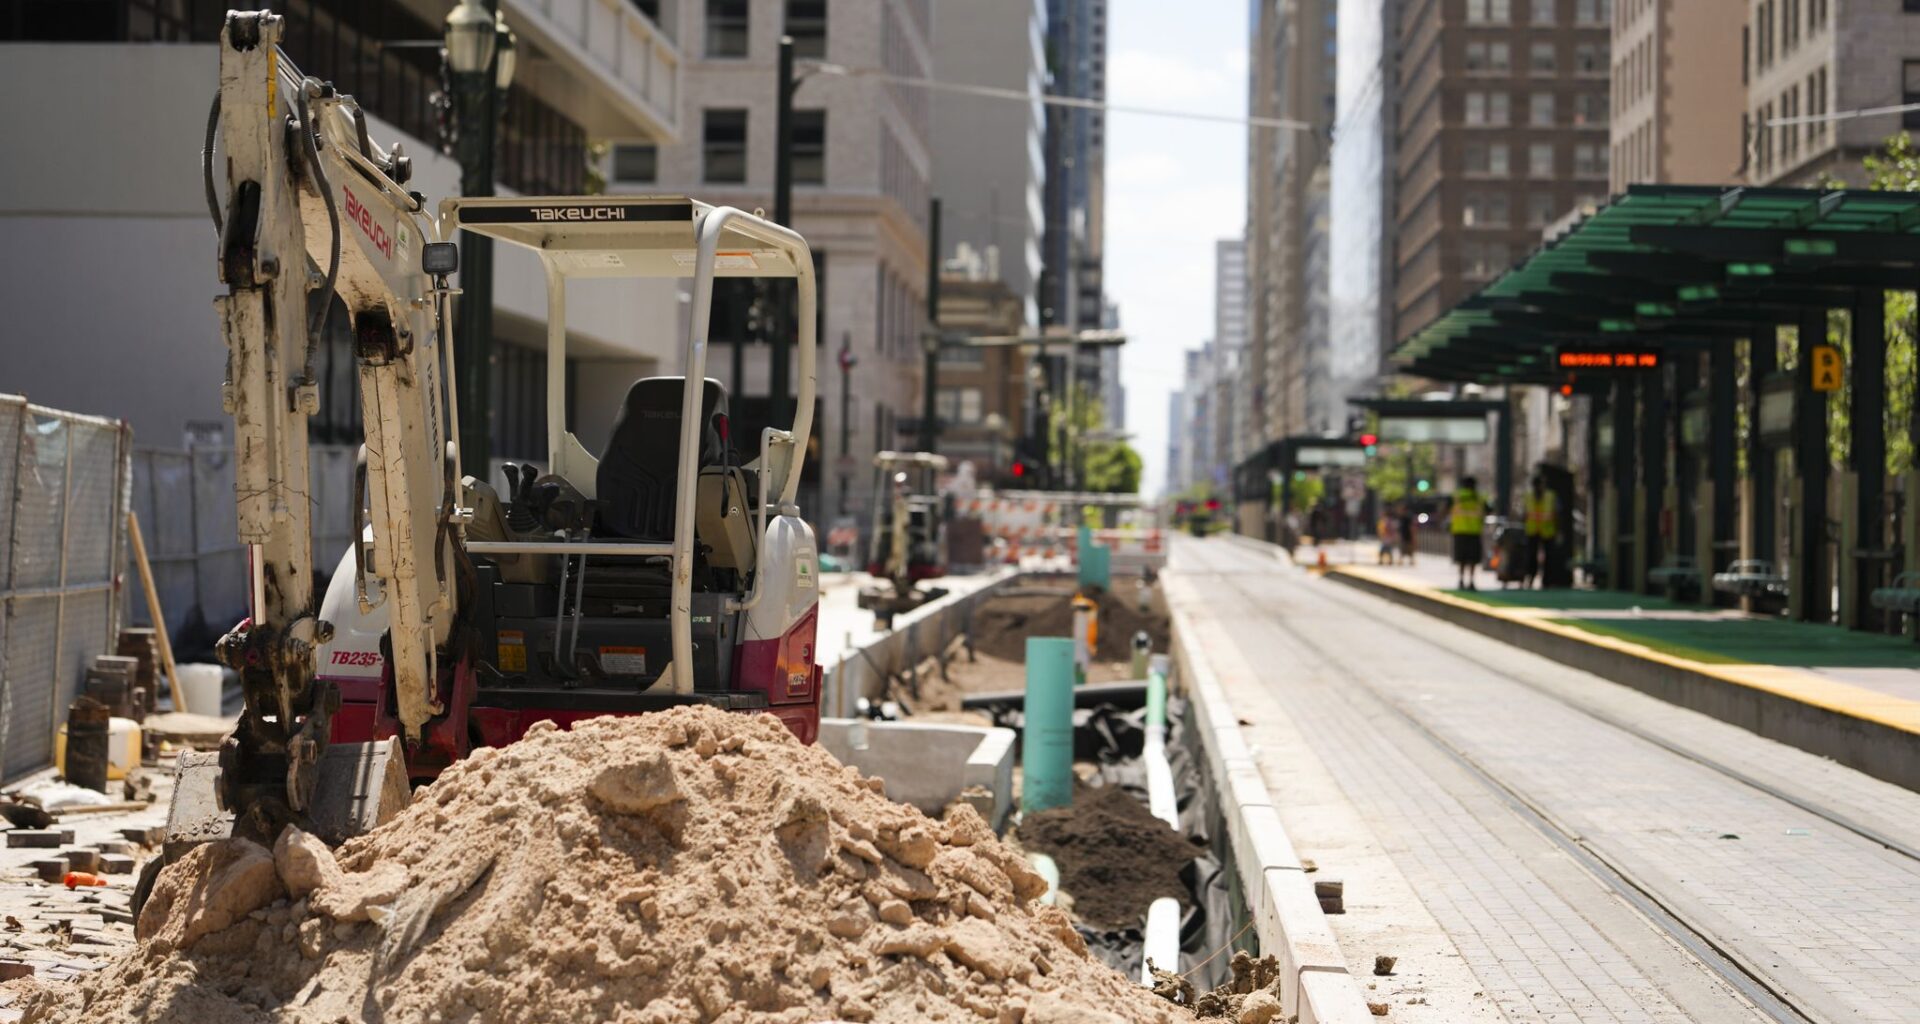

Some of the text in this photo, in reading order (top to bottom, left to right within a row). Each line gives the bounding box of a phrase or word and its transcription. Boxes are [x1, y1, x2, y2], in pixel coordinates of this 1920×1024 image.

[530, 207, 625, 220] TAKEUCHI
[343, 184, 391, 261] TAKEUCHI
[331, 651, 384, 667] TB235-
